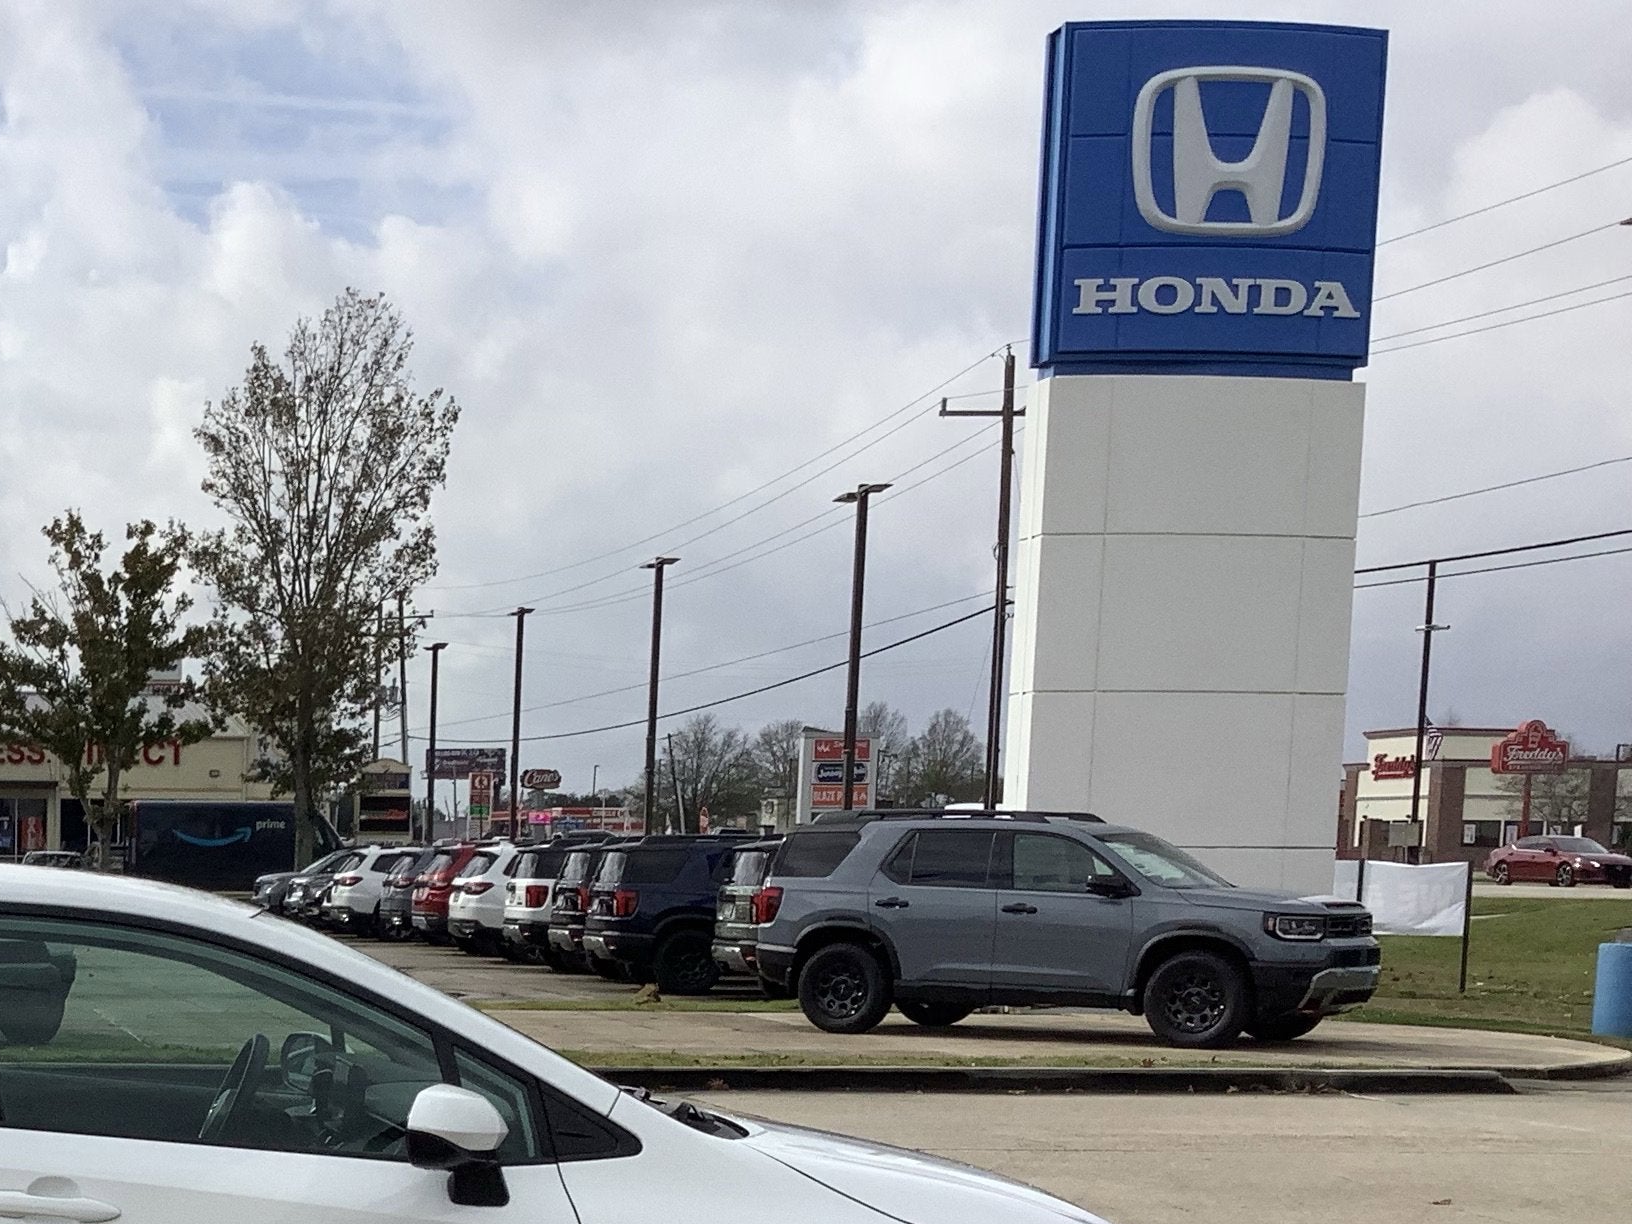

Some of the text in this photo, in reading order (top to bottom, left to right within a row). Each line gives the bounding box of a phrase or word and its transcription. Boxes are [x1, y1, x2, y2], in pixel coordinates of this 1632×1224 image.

[1071, 276, 1361, 318] HONDA
[1503, 745, 1565, 765] Freddy's
[255, 818, 286, 832] prime
